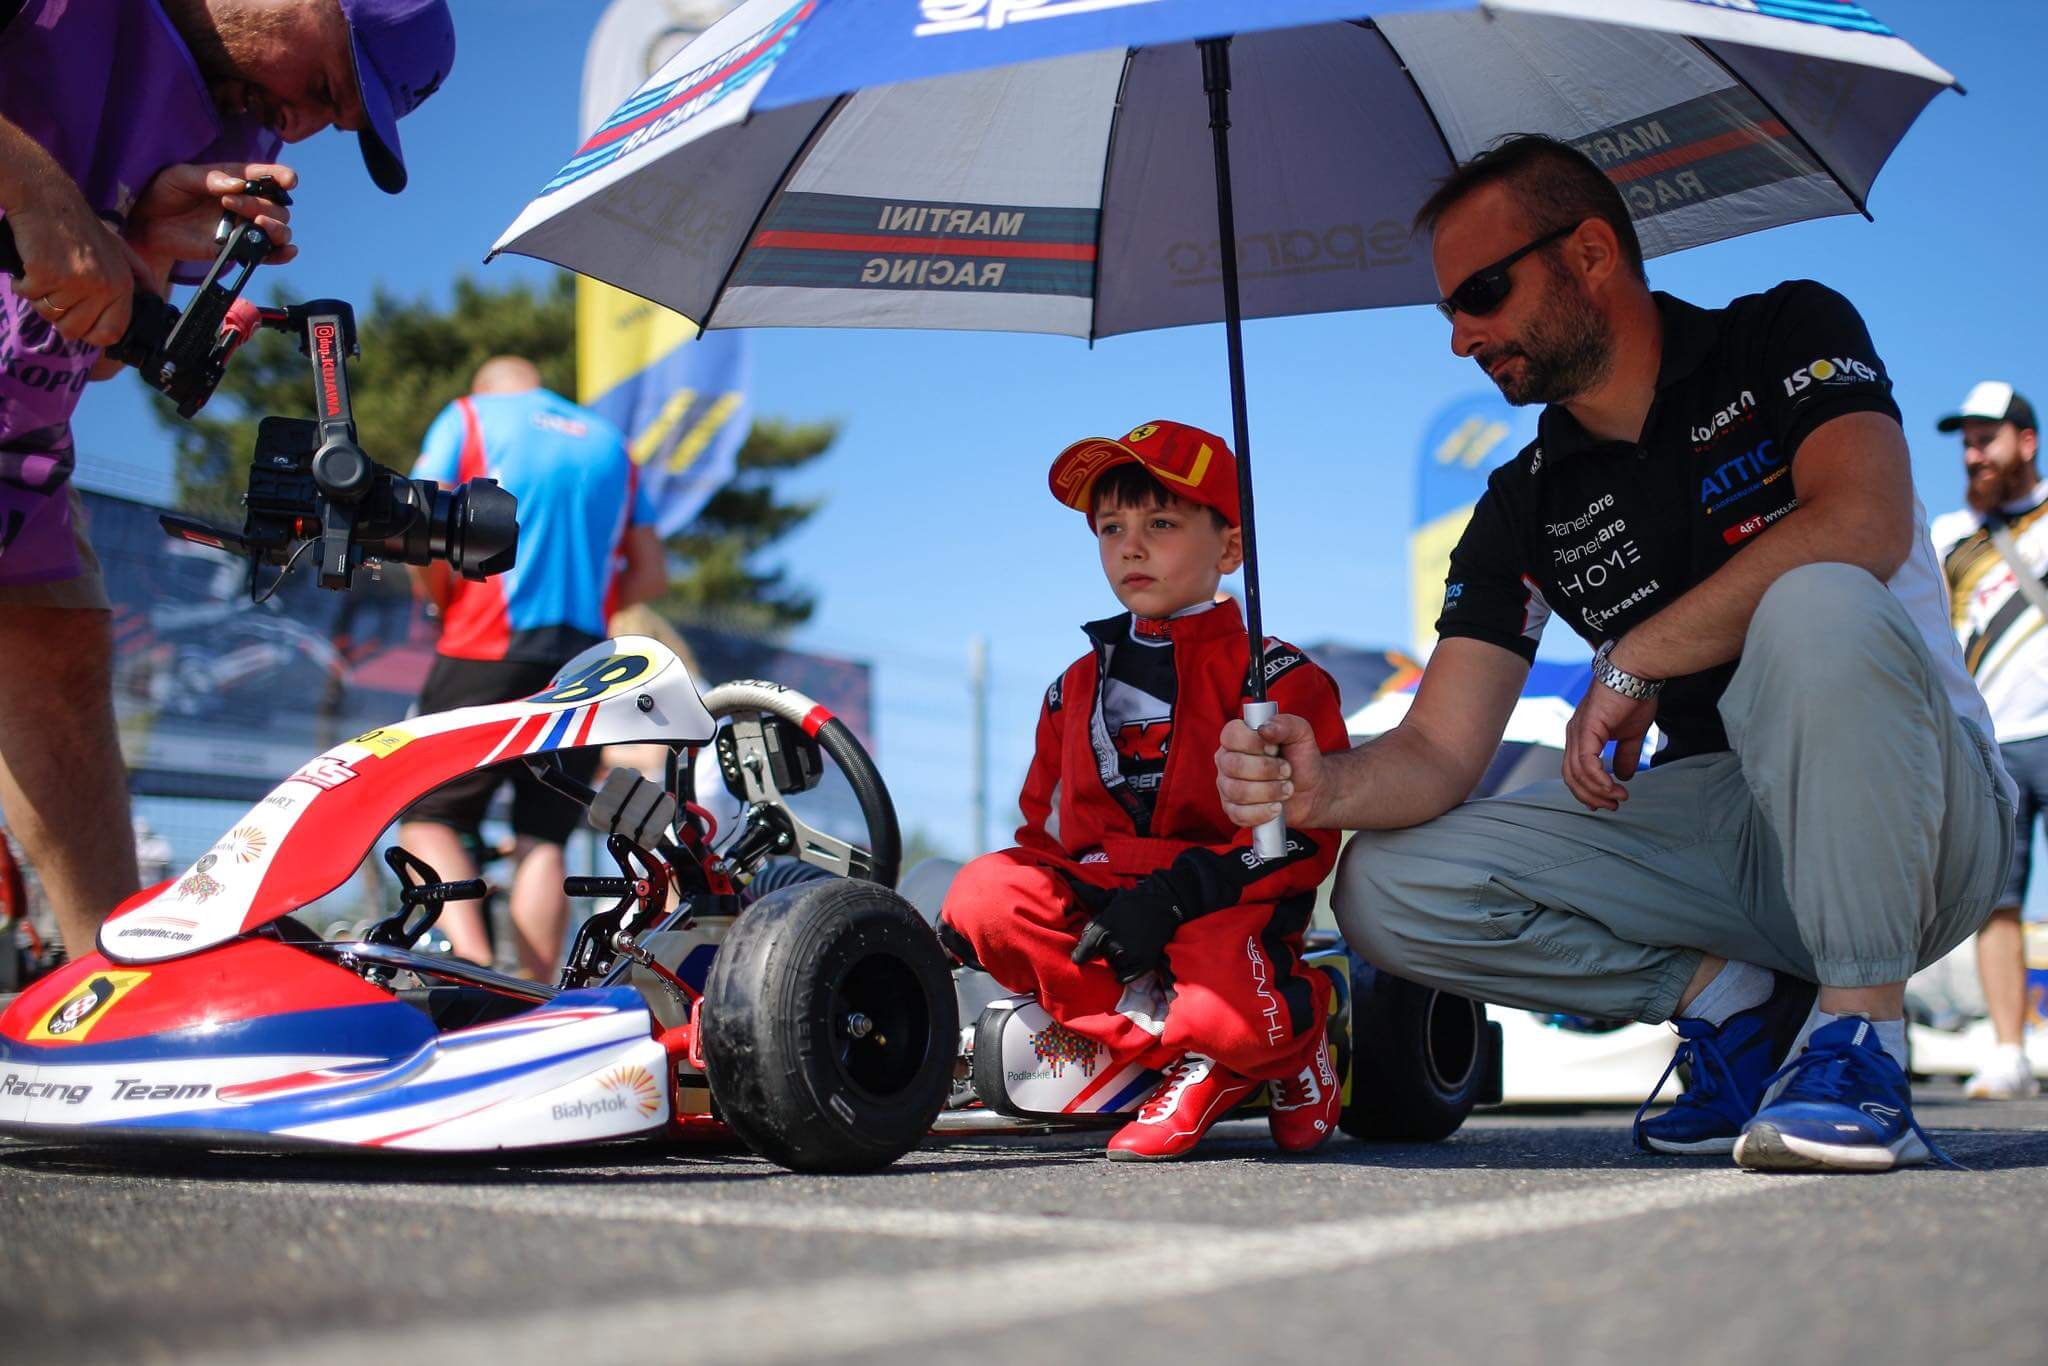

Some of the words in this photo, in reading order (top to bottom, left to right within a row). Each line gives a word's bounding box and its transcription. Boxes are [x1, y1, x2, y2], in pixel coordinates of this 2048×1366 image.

[1056, 442, 1112, 489] 55
[1701, 438, 1783, 504] ATTIC
[1600, 579, 1660, 620] kratki
[0, 1074, 93, 1104] Racing
[110, 1078, 212, 1102] Team
[1007, 1071, 1052, 1082] Podlaskie
[552, 1093, 629, 1121] Białystok
